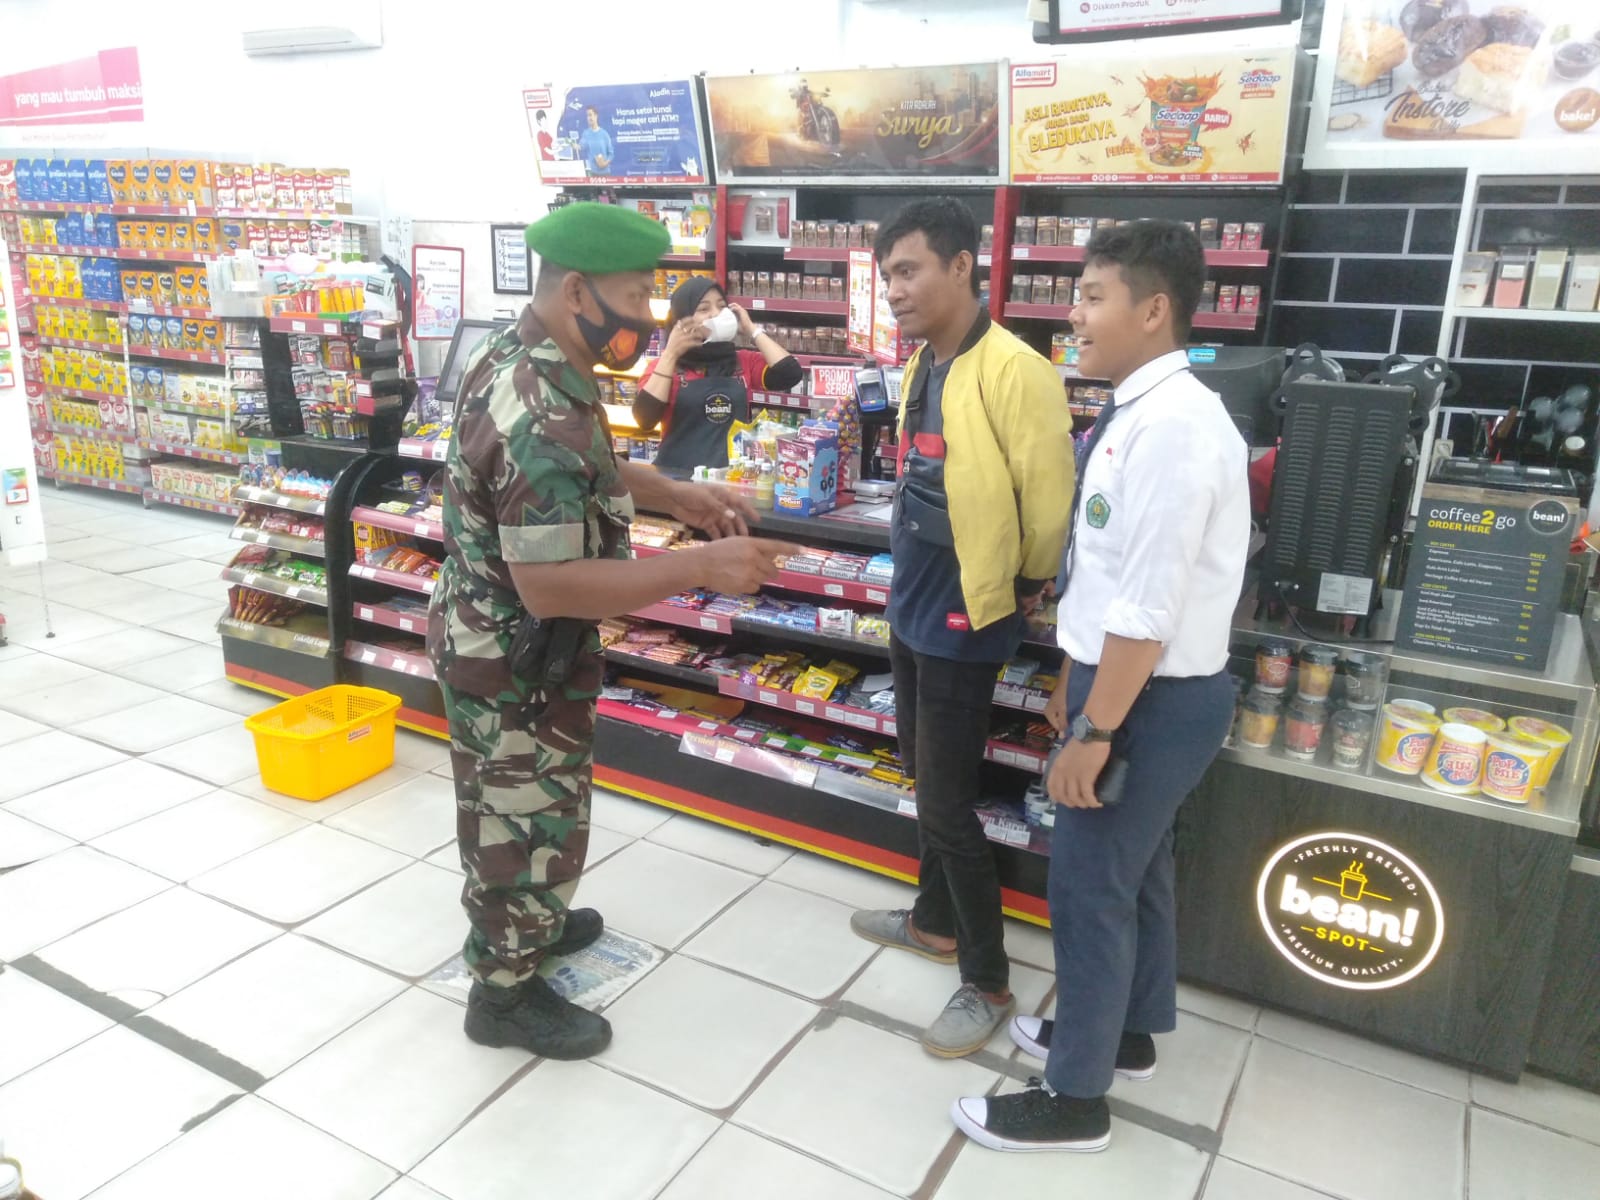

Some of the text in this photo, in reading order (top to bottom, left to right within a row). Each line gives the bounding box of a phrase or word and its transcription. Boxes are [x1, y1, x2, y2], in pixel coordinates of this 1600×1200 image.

[1093, 2, 1120, 11] Diskon
[1016, 69, 1051, 77] Alfamart
[1239, 74, 1281, 84] Sedaap
[14, 93, 40, 108] yang
[41, 90, 63, 104] mau
[63, 85, 105, 103] tumbuh
[1024, 104, 1049, 122] ASLI
[1384, 91, 1473, 123] Instore
[1157, 109, 1199, 122] Sedaap
[1560, 108, 1596, 122] bake!
[878, 108, 963, 148] Surya
[1028, 119, 1117, 153] BLEDUKNYA
[819, 369, 850, 383] PROMO
[825, 383, 853, 396] SERBA
[705, 403, 732, 414] bean!
[1430, 507, 1516, 530] coffee2go
[1533, 511, 1565, 523] bean!
[1428, 520, 1491, 536] ORDER HERE
[1491, 755, 1517, 769] POP
[1493, 767, 1522, 779] MIE
[1298, 845, 1417, 892] FRESHLY BREWED
[1280, 874, 1420, 947] bean!
[1315, 927, 1369, 951] SPOT
[1284, 928, 1399, 976] PREMIUM QUALITY
